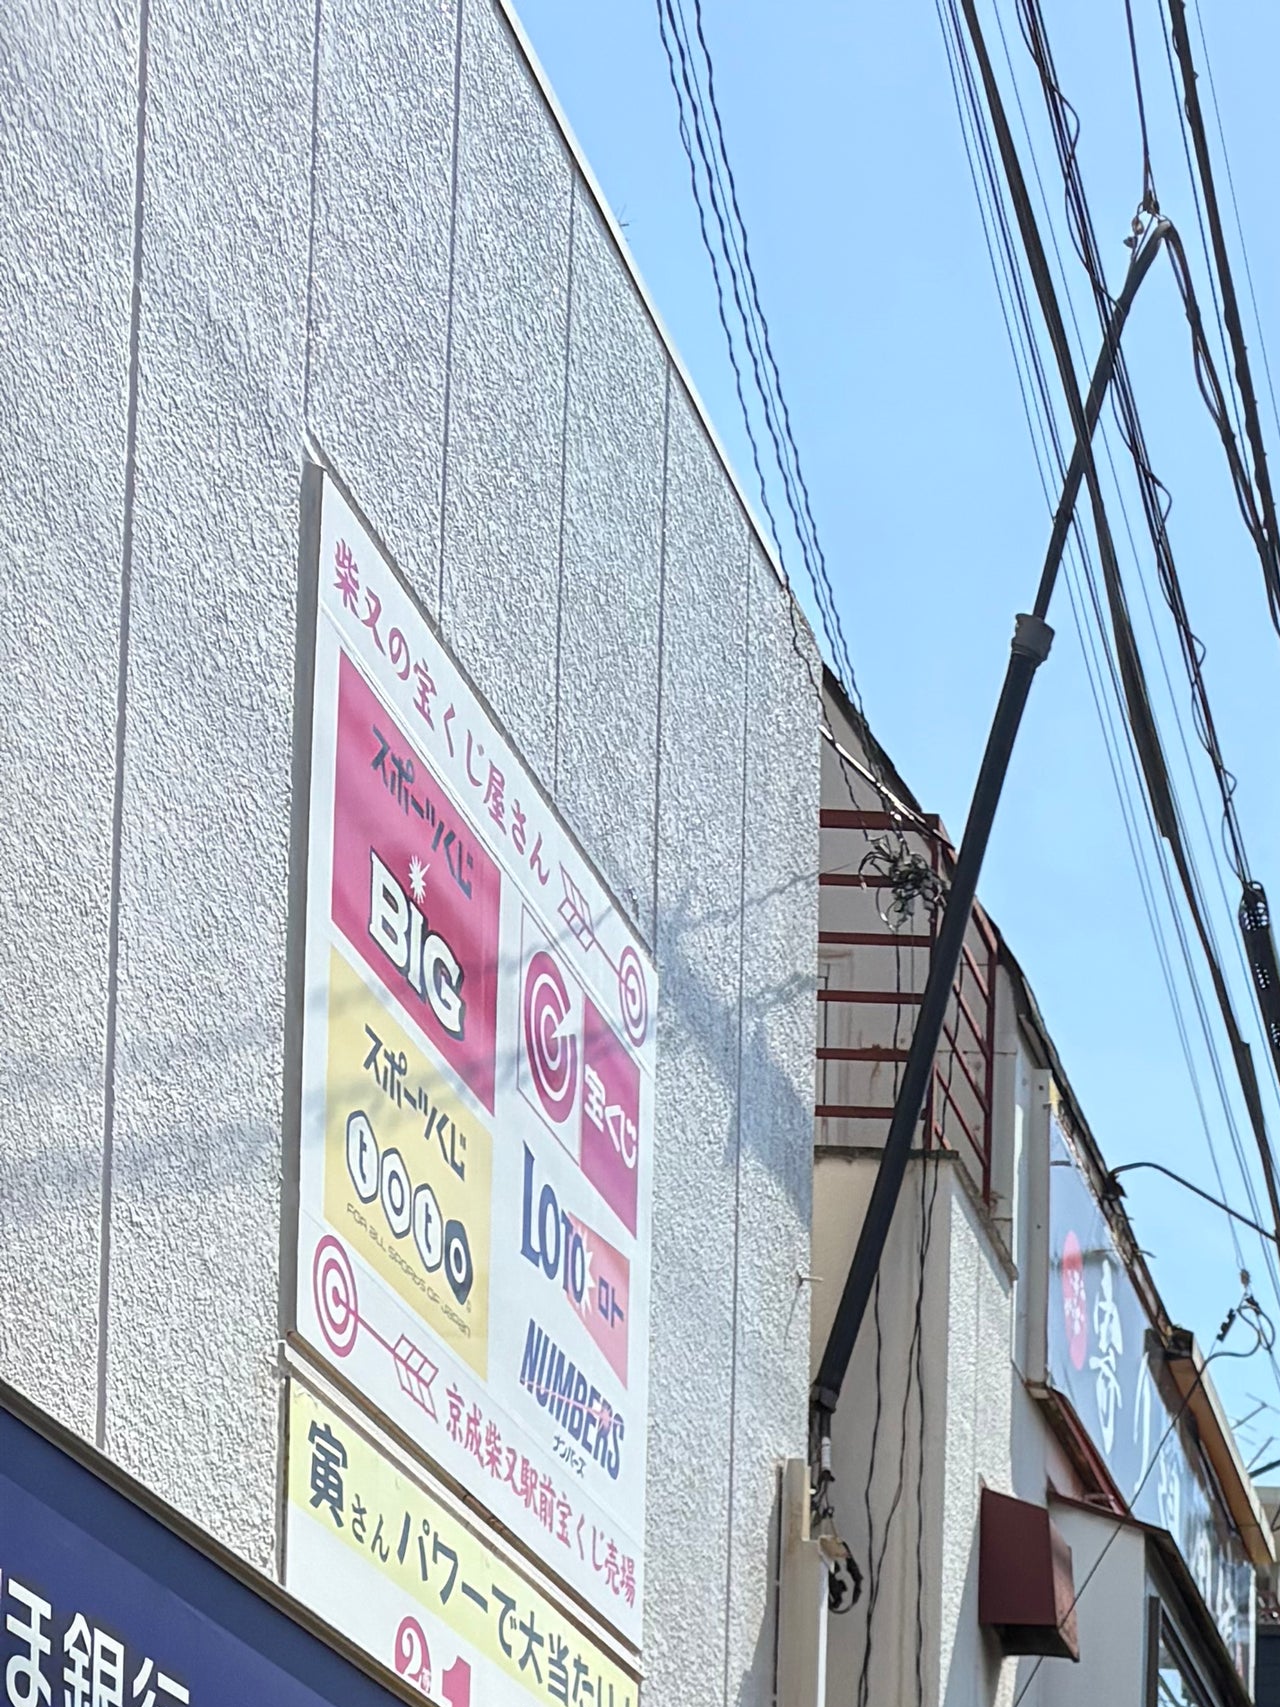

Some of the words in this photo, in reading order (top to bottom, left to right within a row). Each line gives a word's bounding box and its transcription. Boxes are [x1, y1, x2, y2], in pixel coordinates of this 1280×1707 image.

[332, 538, 551, 887] 柴又の宝くじ屋さん
[370, 723, 474, 899] スポーツくじ
[367, 846, 467, 1041] BIG
[361, 1023, 469, 1183] スポーツくじ
[582, 1066, 638, 1170] 宝くじ
[346, 1110, 474, 1305] toto
[520, 1140, 586, 1304] LOTO
[598, 1279, 624, 1329] ロト
[519, 1318, 624, 1480] NUMBERS
[551, 1434, 587, 1478] ナンバーズ
[445, 1384, 636, 1609] 京成柴又駅前宝くじ売場
